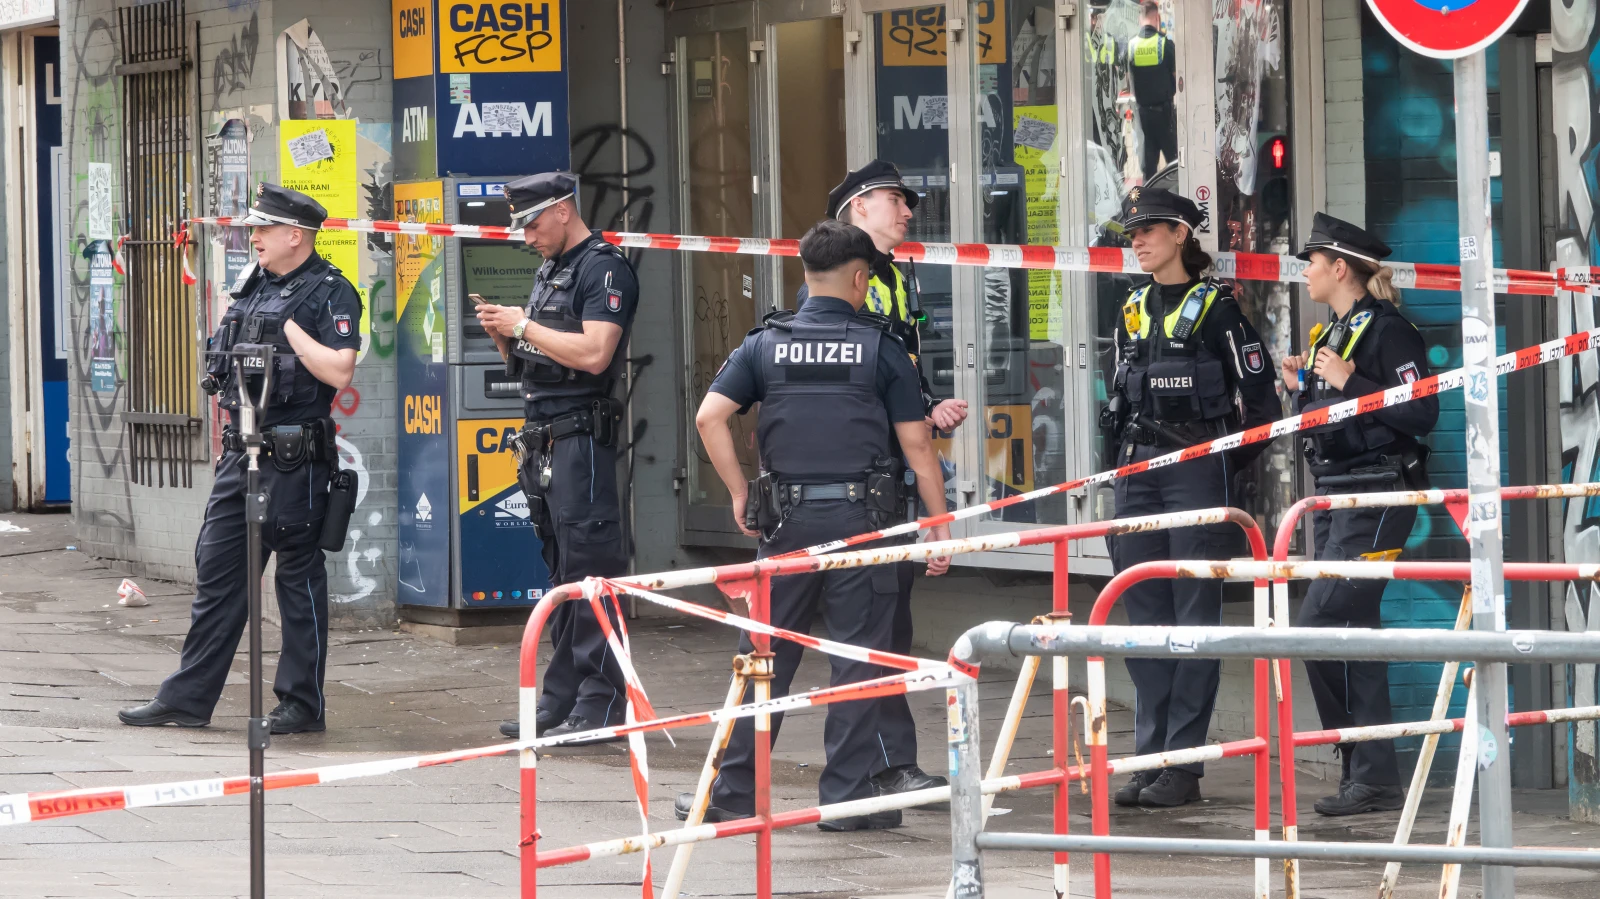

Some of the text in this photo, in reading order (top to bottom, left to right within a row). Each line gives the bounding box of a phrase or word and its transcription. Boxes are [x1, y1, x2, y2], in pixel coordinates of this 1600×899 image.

[400, 7, 425, 38] CASH
[450, 3, 550, 32] CASH
[454, 31, 553, 67] FCSP
[402, 106, 428, 143] ATM
[453, 101, 553, 138] AM
[223, 139, 247, 154] ALTONA
[91, 253, 112, 268] ALTONA
[774, 342, 862, 364] POLIZEI
[1169, 341, 1184, 349] Timm
[1150, 376, 1193, 389] POLIZEI
[404, 395, 442, 434] CASH
